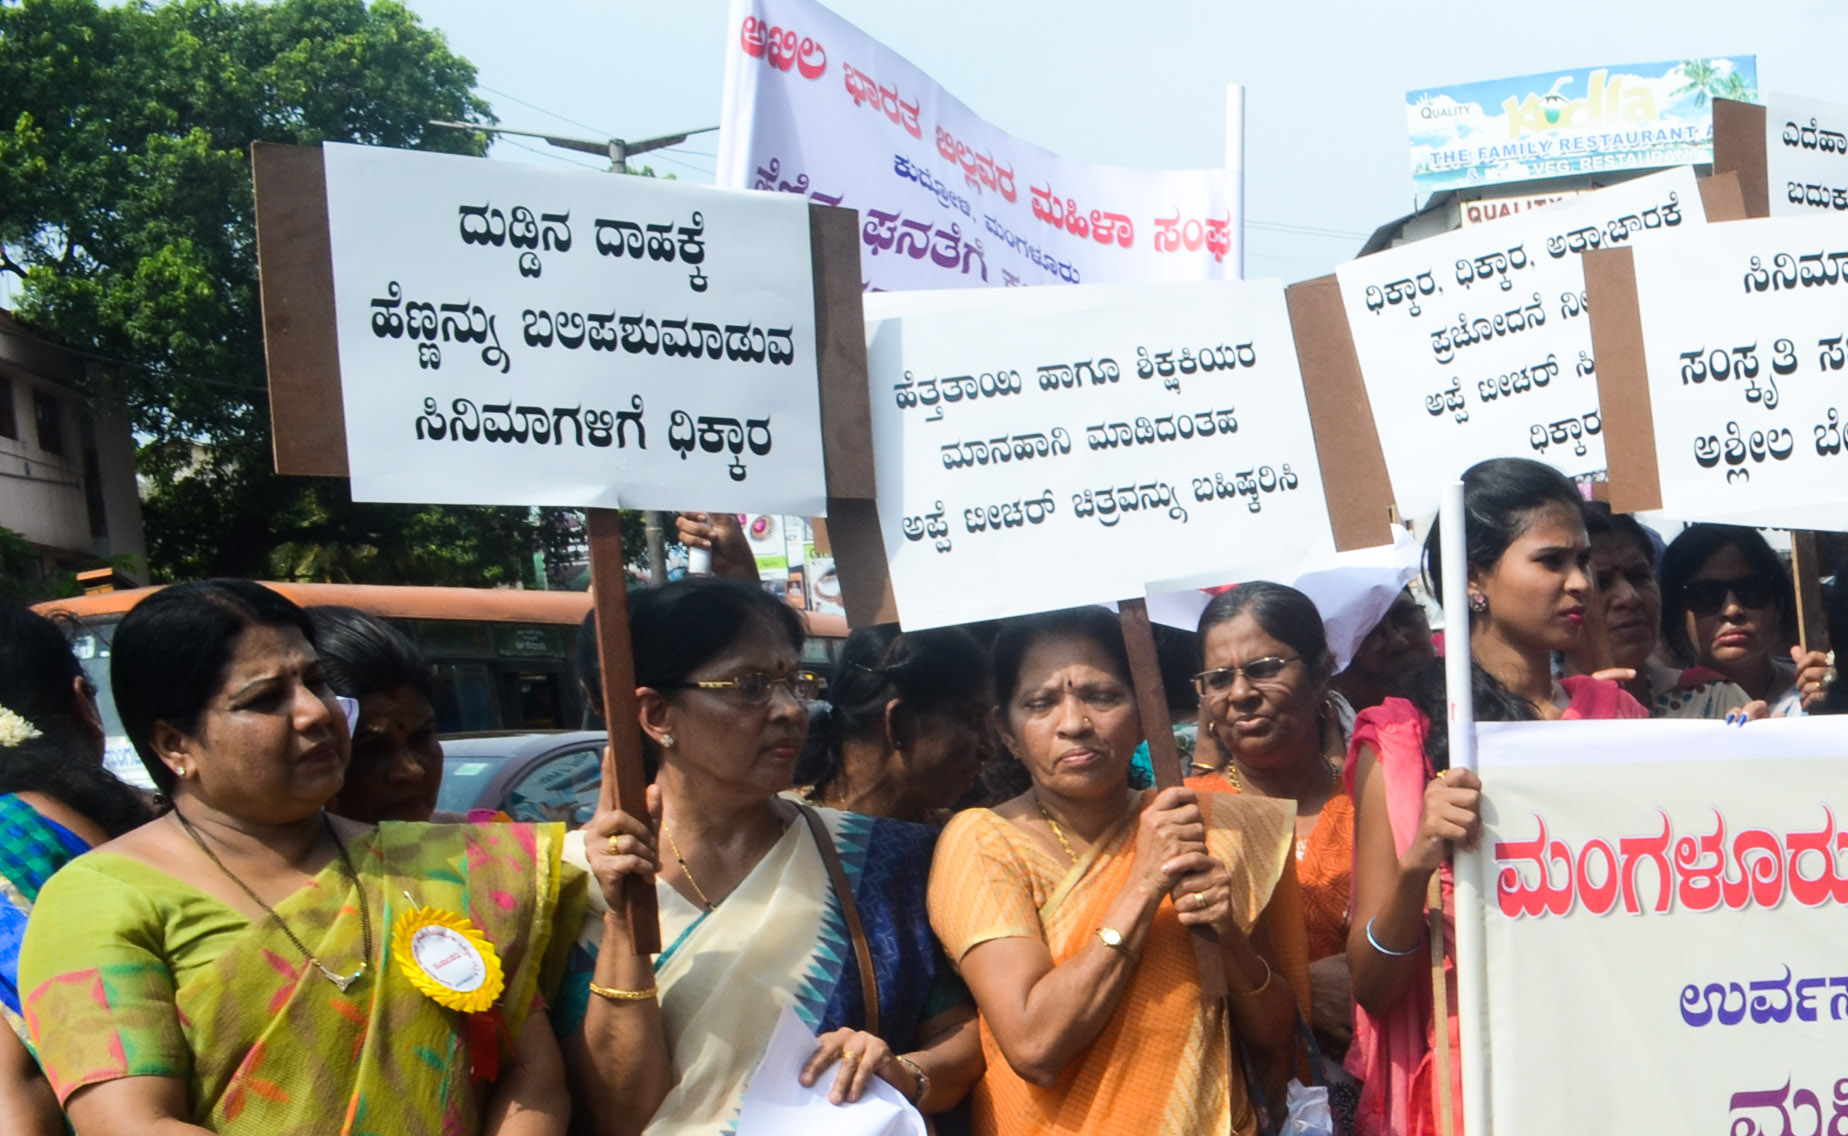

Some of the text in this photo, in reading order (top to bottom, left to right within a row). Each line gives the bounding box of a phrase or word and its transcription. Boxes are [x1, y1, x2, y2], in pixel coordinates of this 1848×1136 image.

[741, 16, 1231, 262] ಅಖಿಲ ಭಾರತ ಬಿಲ್ಲವರ ಮಹಿಳಾ ಸಂಘ
[1421, 103, 1471, 120] QUALITY
[1430, 151, 1471, 167] THE
[1478, 140, 1549, 160] FAMILY
[1559, 126, 1696, 150] RESTAURANT
[1533, 158, 1576, 176] VEG.
[1581, 148, 1699, 171] RESTAURANT
[457, 204, 709, 293] ದುಡ್ಡಿನ ದಾಹಕ್ಕೆ
[863, 208, 988, 283] ಘನತೆಗೆ
[370, 280, 794, 372] ಹೆಣ್ಣನ್ನು ಬಲಿಪಶುಮಾಡುವ
[1430, 292, 1546, 364] ಪ್ರಚೋದನೆ
[1037, 354, 1119, 392] ಹಾಗೂ
[1136, 340, 1256, 395] ಶಿಕ್ಷಕಿಯರ
[1478, 354, 1558, 402] ಟೀಚರ್
[1679, 337, 1798, 409] ಸಂಸ್ಕೃತಿ
[415, 394, 772, 481] ಸಿನಿಮಾಗಳಿಗೆ ಧಿಕ್ಕಾರ
[941, 406, 1238, 471] ಮಾನಹಾನಿ ಮಾಡಿದಂತಹ
[1693, 421, 1793, 486] ಅಶ್ಲೀಲ
[964, 489, 1056, 534] ಟೀಚರ್
[1072, 480, 1188, 527] ಚಿತ್ರವನ್ನು
